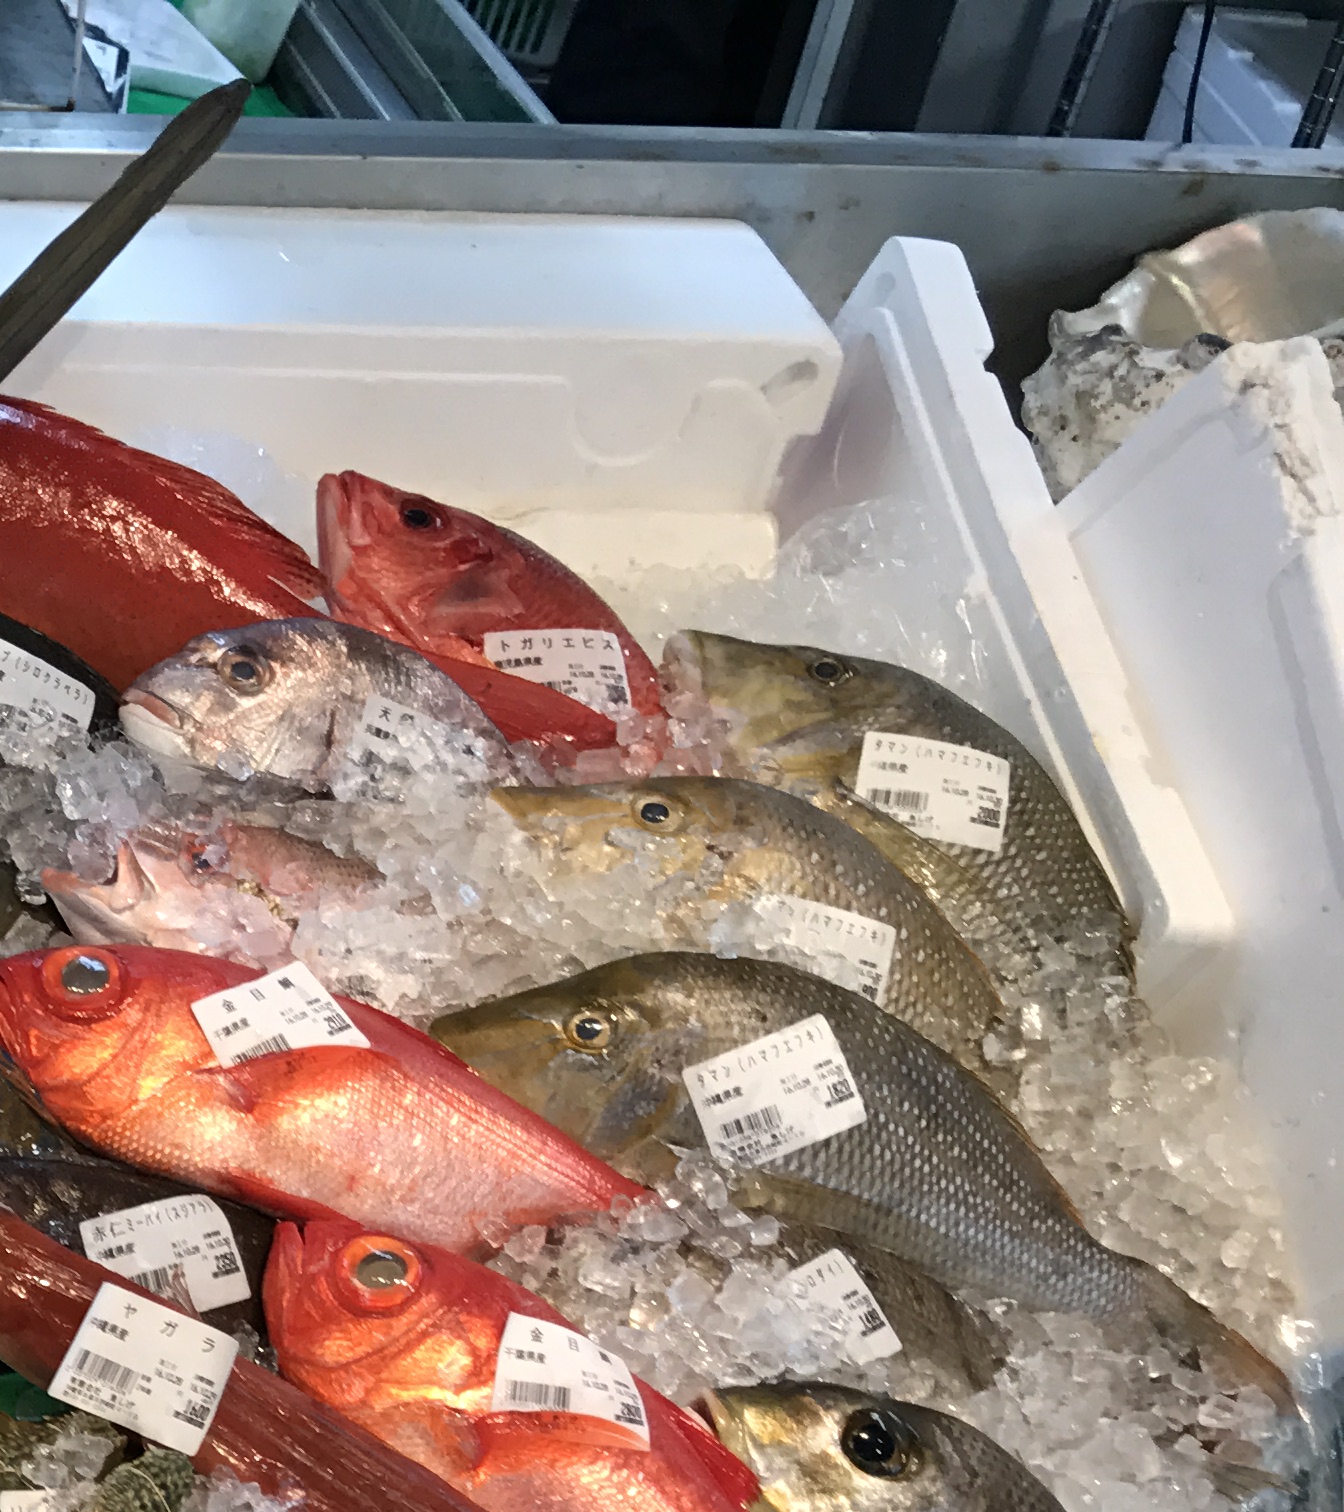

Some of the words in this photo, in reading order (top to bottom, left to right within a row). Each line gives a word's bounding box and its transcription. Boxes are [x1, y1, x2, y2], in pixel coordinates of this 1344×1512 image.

[222, 977, 294, 1012] 金目鯛
[324, 1011, 346, 1030] 2910
[697, 1025, 824, 1088] タマン（ハマフエフキ）
[91, 1200, 214, 1244] 赤仁ミーバイ（スジアラ）
[124, 1302, 215, 1353] ヤガラ
